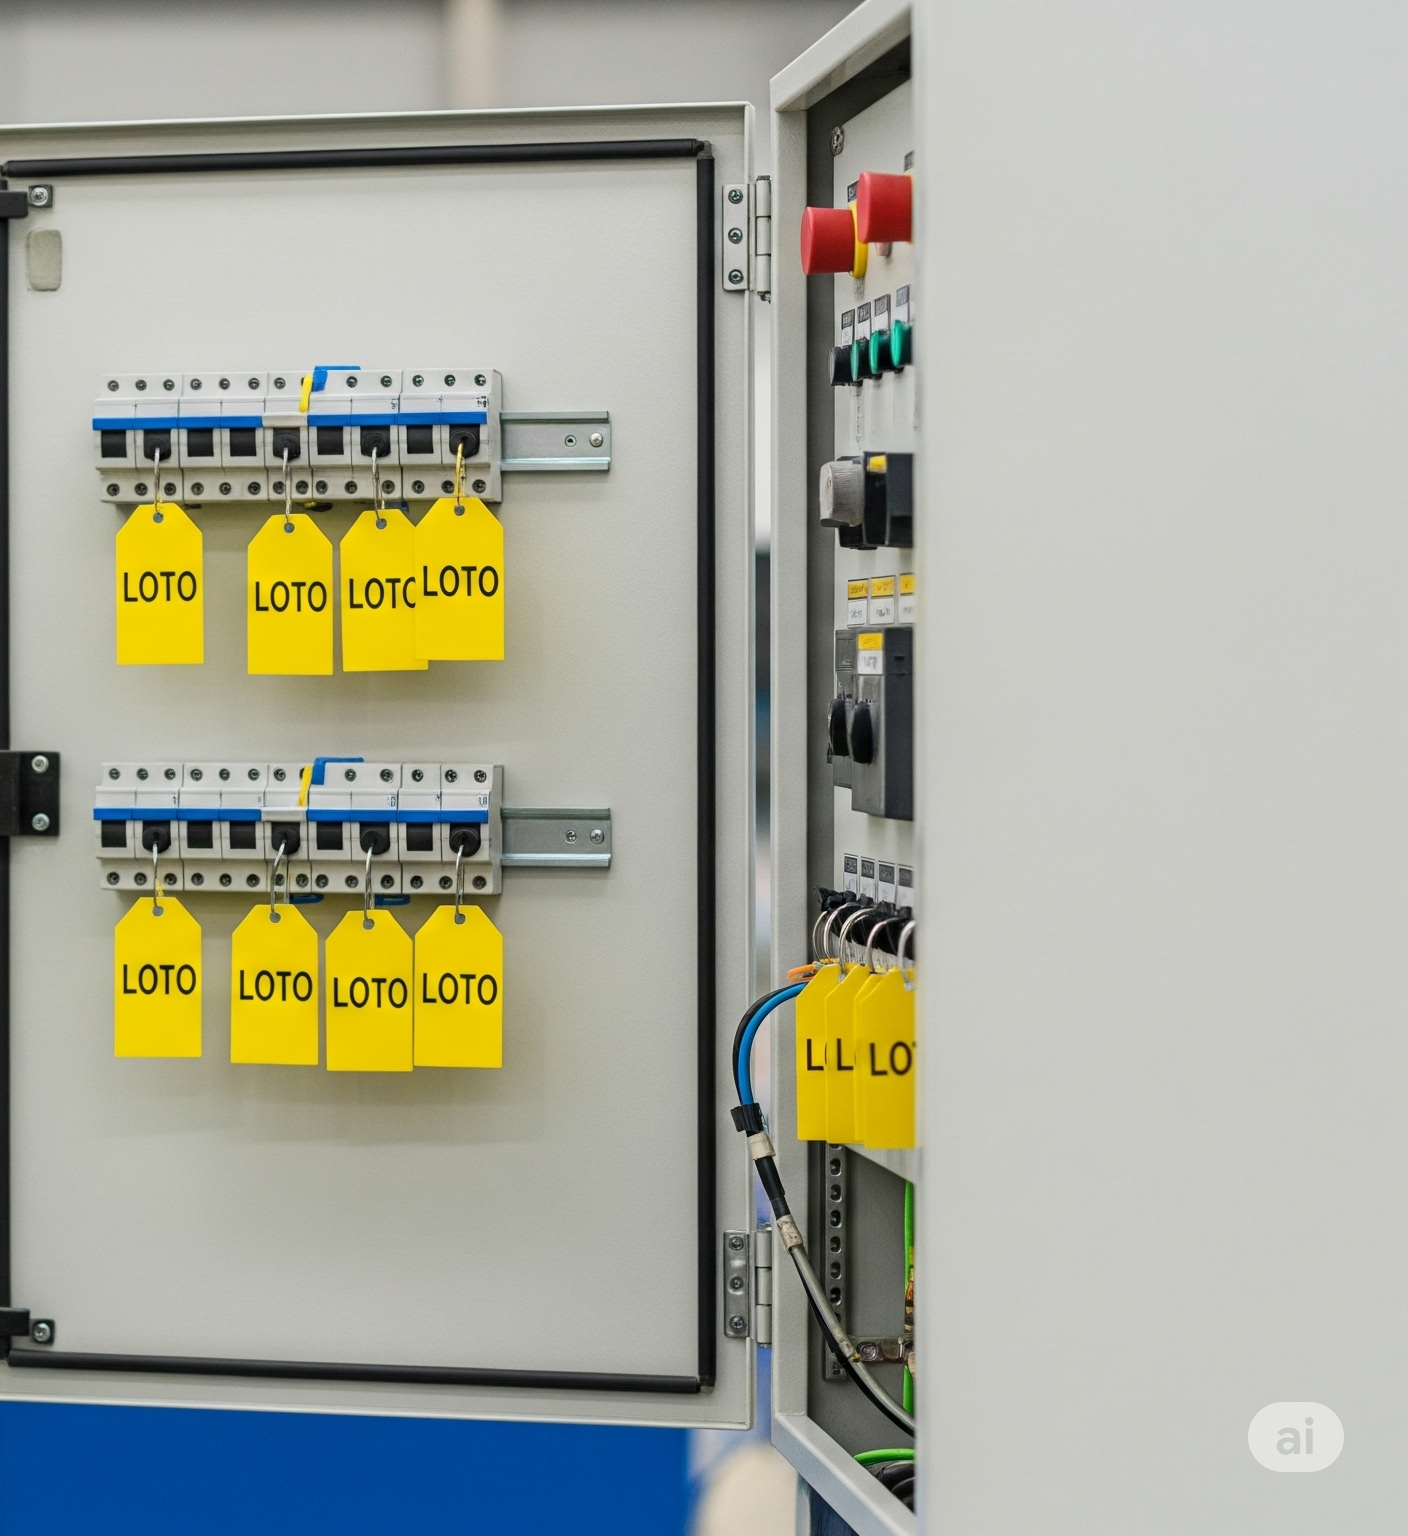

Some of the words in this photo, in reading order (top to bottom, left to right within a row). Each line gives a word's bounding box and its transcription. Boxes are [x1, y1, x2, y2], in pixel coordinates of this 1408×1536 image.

[123, 571, 197, 603] LOTO
[255, 580, 328, 613] LOTO
[422, 564, 499, 598] LOTO
[122, 963, 197, 996] LOTO
[239, 969, 313, 1002] LOTO
[333, 976, 408, 1009] LOTO
[422, 972, 498, 1006] LOTO
[869, 1041, 916, 1077] LO
